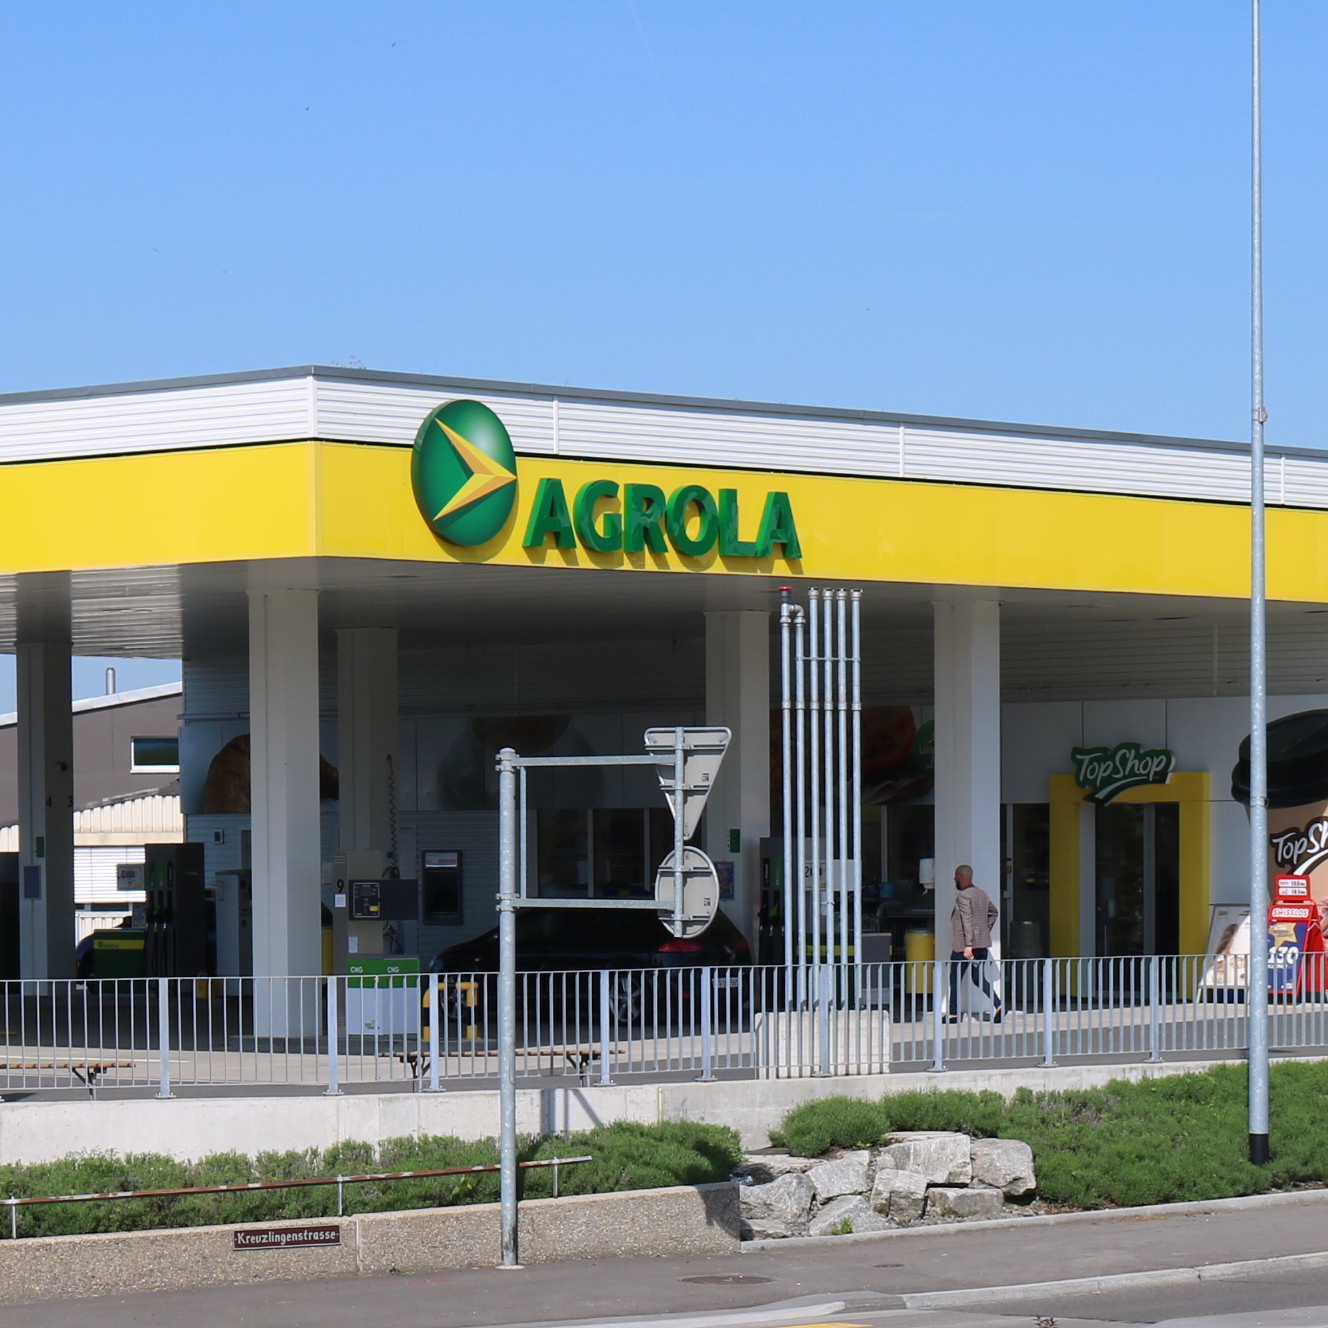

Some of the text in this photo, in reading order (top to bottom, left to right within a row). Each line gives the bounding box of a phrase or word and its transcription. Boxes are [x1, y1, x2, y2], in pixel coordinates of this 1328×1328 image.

[523, 478, 802, 559] AGROLA
[1076, 748, 1167, 787] TopShop
[336, 880, 344, 894] 9
[1273, 909, 1308, 917] SWISSLOS
[236, 1230, 336, 1246] Kreuzlingenstrasse
